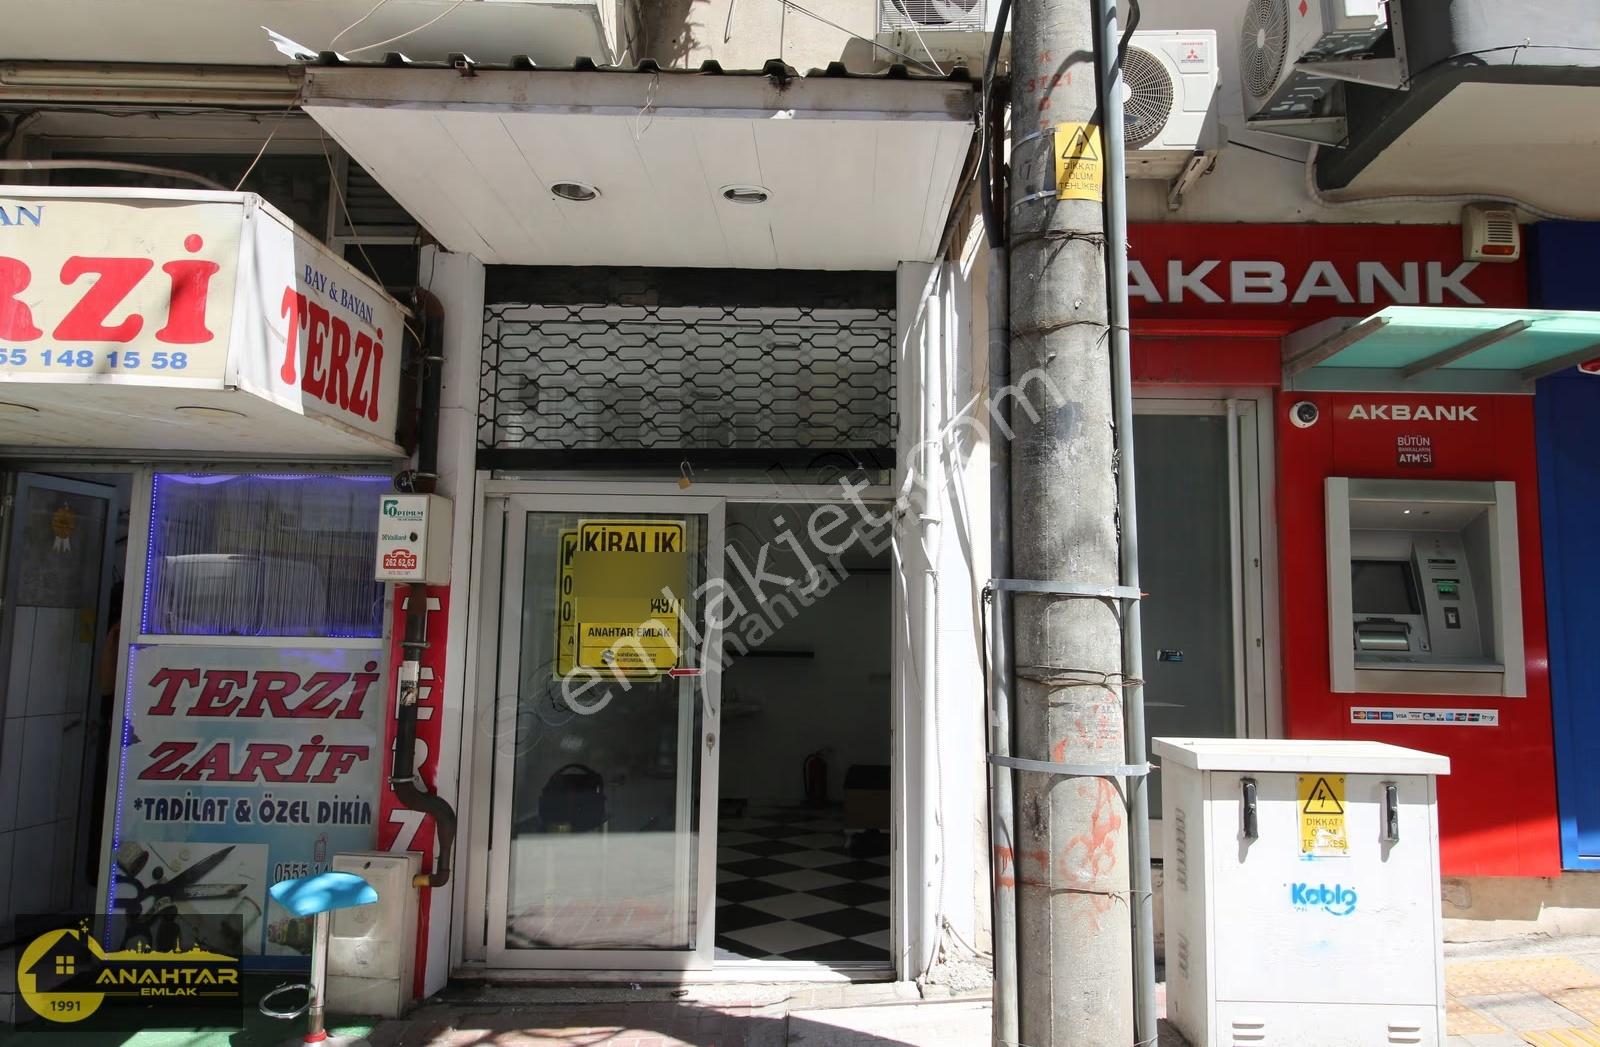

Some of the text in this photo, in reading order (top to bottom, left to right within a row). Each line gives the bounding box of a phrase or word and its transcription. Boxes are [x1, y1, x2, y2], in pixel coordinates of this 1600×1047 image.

[304, 264, 373, 324] BAY & BAYAN
[1129, 260, 1486, 305] AKBANK
[41, 350, 94, 368] 148
[106, 351, 140, 369] 15
[151, 352, 188, 370] 58
[280, 285, 384, 422] TERZİ
[1348, 404, 1479, 421] AKBANK
[1397, 434, 1430, 446] BÜTÜN
[588, 627, 670, 638] ANAHTAR EMLAK
[147, 660, 380, 720] TERZİ
[137, 734, 369, 784] ZARİF
[235, 799, 251, 823] &
[259, 793, 310, 824] ÖZEL
